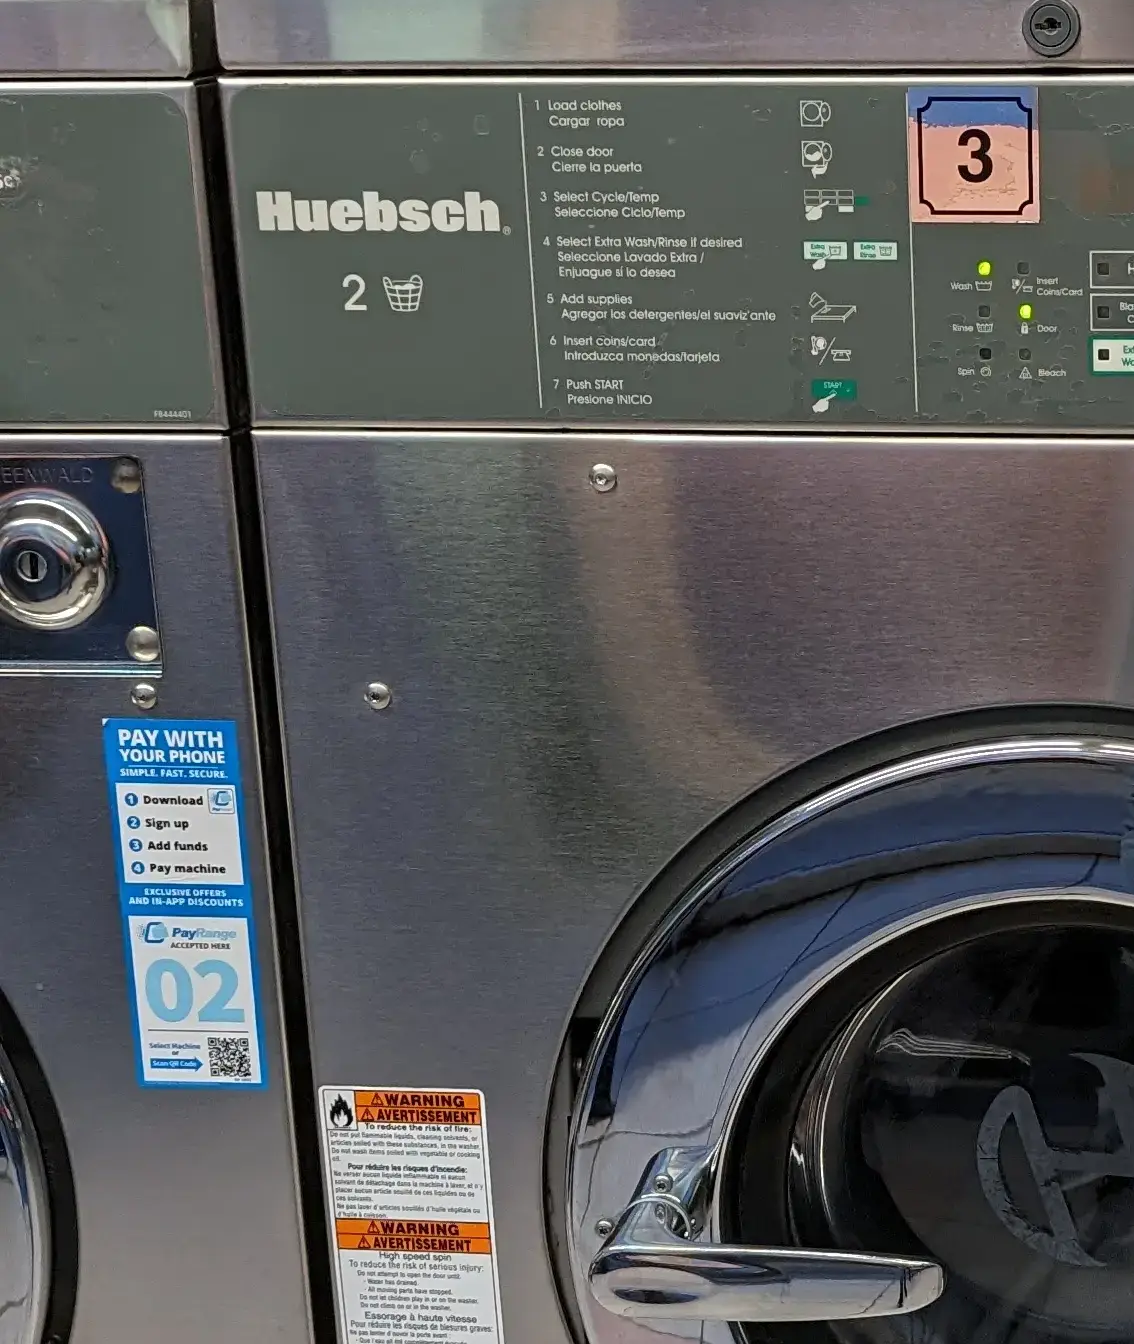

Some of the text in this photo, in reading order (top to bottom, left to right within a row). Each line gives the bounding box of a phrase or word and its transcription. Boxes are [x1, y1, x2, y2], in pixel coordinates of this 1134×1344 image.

[534, 100, 622, 111] 1 Load clothes
[549, 116, 625, 128] Cargar ropa
[537, 146, 614, 157] 2 Close door
[958, 129, 993, 183] 3
[552, 162, 642, 174] Cierre la puerta
[540, 191, 660, 204] 3 Select Cycle/Temp
[256, 191, 500, 233] Huebsch
[555, 207, 685, 219] Seleccione Ciclo/Temp
[543, 237, 742, 248] 4 Select Extra Wash/Rinse if desired
[558, 252, 697, 263] Seleccione Lavado Extra
[559, 266, 676, 279] Enjuague sí lo desea
[950, 282, 973, 291] Wash
[1037, 277, 1059, 285] Insert
[341, 274, 368, 311] 2
[1037, 288, 1083, 296] Coins/Card
[547, 294, 633, 306] 5 Add supplies
[561, 310, 607, 322] Agregar
[611, 310, 626, 320] los
[629, 310, 710, 322] detergentes/el
[953, 324, 973, 332] Rinse
[1037, 324, 1057, 332] Door
[550, 335, 656, 347] 6 Insert coins/card
[564, 351, 720, 363] Introduzca monedas/tarjeta
[958, 367, 974, 377] Spin
[553, 379, 623, 390] 7 Push START
[567, 394, 653, 405] Presione INICIO
[0, 467, 93, 483] EENWALD
[118, 729, 223, 748] PAY WITH
[119, 748, 225, 764] YOUR PHONE
[143, 795, 203, 806] Download
[145, 818, 189, 830] Sign up
[148, 841, 208, 851] Add funds
[150, 864, 226, 875] Pay machine
[172, 927, 236, 940] PayRange
[145, 958, 245, 1023] 02
[385, 1094, 465, 1107] WARNING
[377, 1109, 477, 1124] AVERTISSEMENT
[380, 1222, 459, 1236] WARNING
[373, 1237, 471, 1251] AVERTISSEMENT
